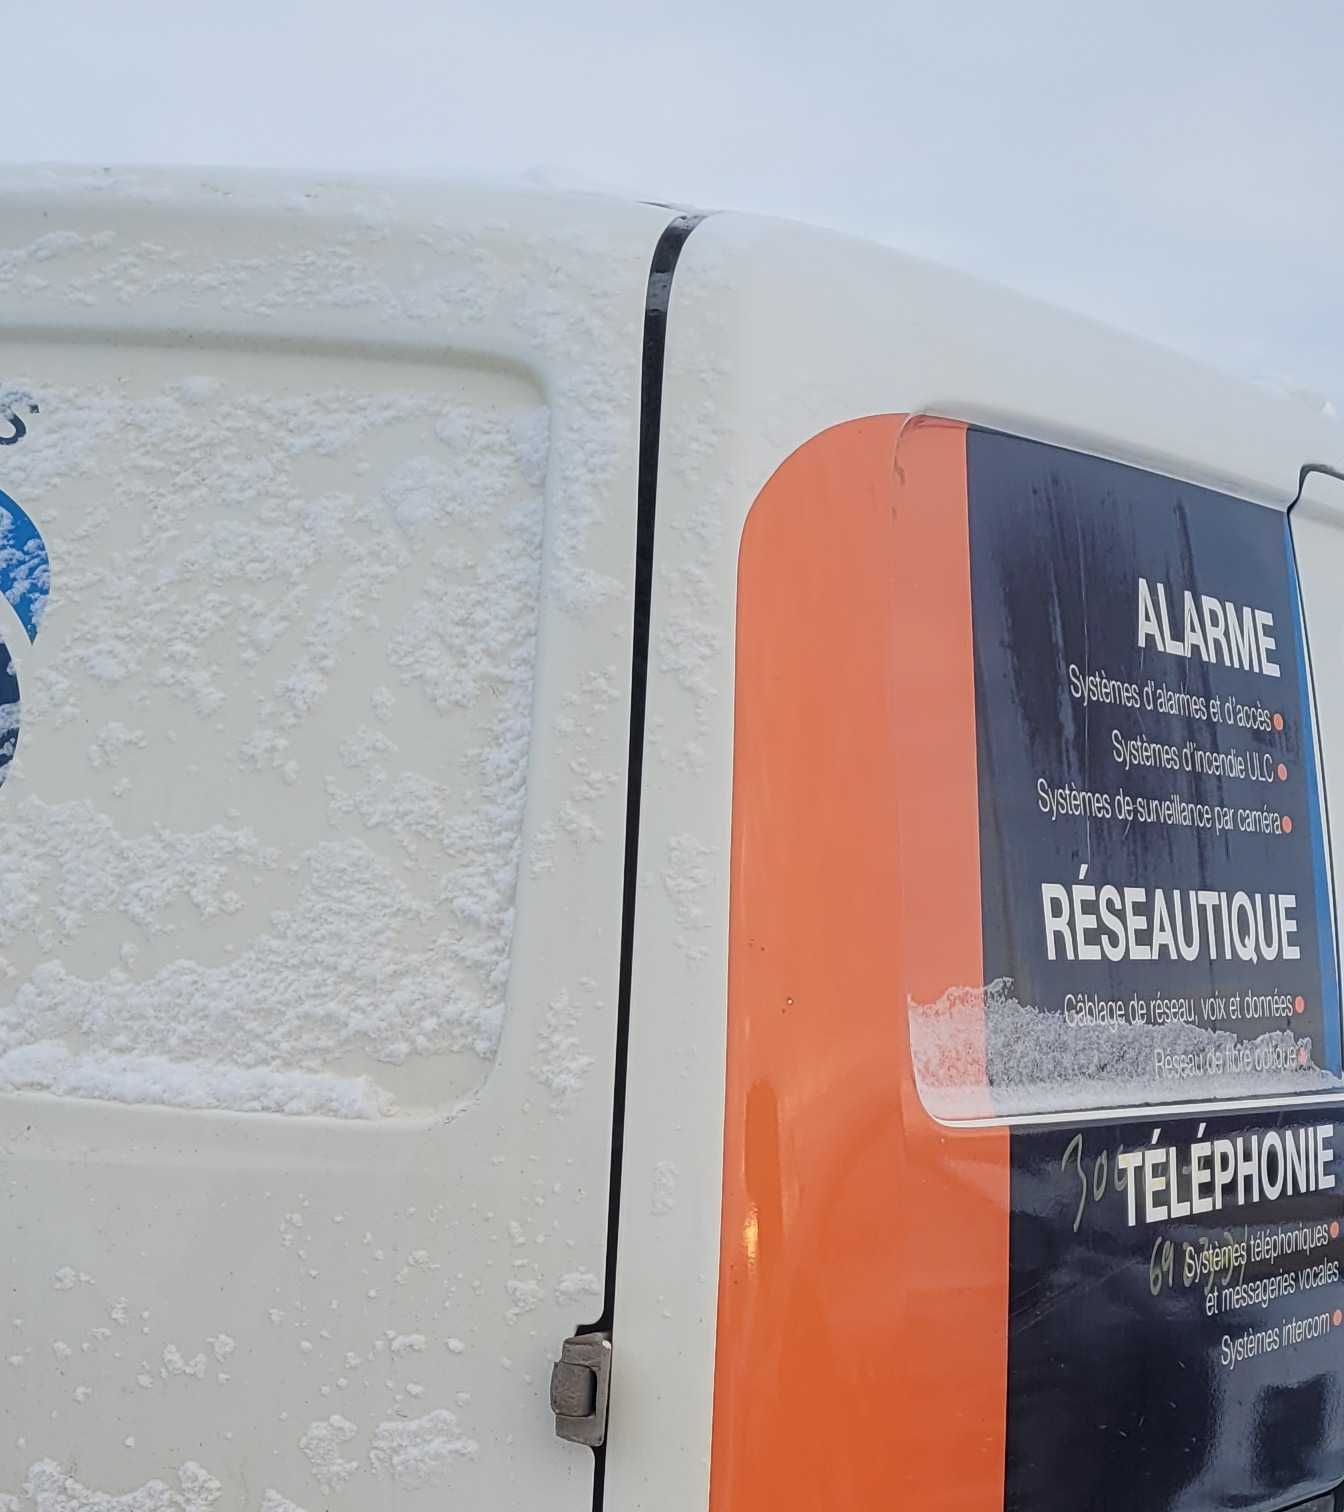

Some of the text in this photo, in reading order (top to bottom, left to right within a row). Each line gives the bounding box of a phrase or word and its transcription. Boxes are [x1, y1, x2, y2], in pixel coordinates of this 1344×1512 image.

[1137, 577, 1281, 678] ALARME
[1069, 664, 1272, 732] Systèmes d'alarmes et d'accès
[1112, 729, 1274, 783] Systèmes d'incendie ULC
[1037, 778, 1283, 836] Systèmes de surveillance par caméra
[1042, 863, 1301, 964] RÉSEAUTIQUE
[1064, 988, 1293, 1032] Câblage de réseau, voix et données
[1118, 1122, 1337, 1228] TÉLÉPHONIE
[1185, 1222, 1330, 1284] Systèmes téléphoniques
[1206, 1257, 1340, 1317] et messageries vocales
[1221, 1310, 1332, 1371] Systèmes intercom
